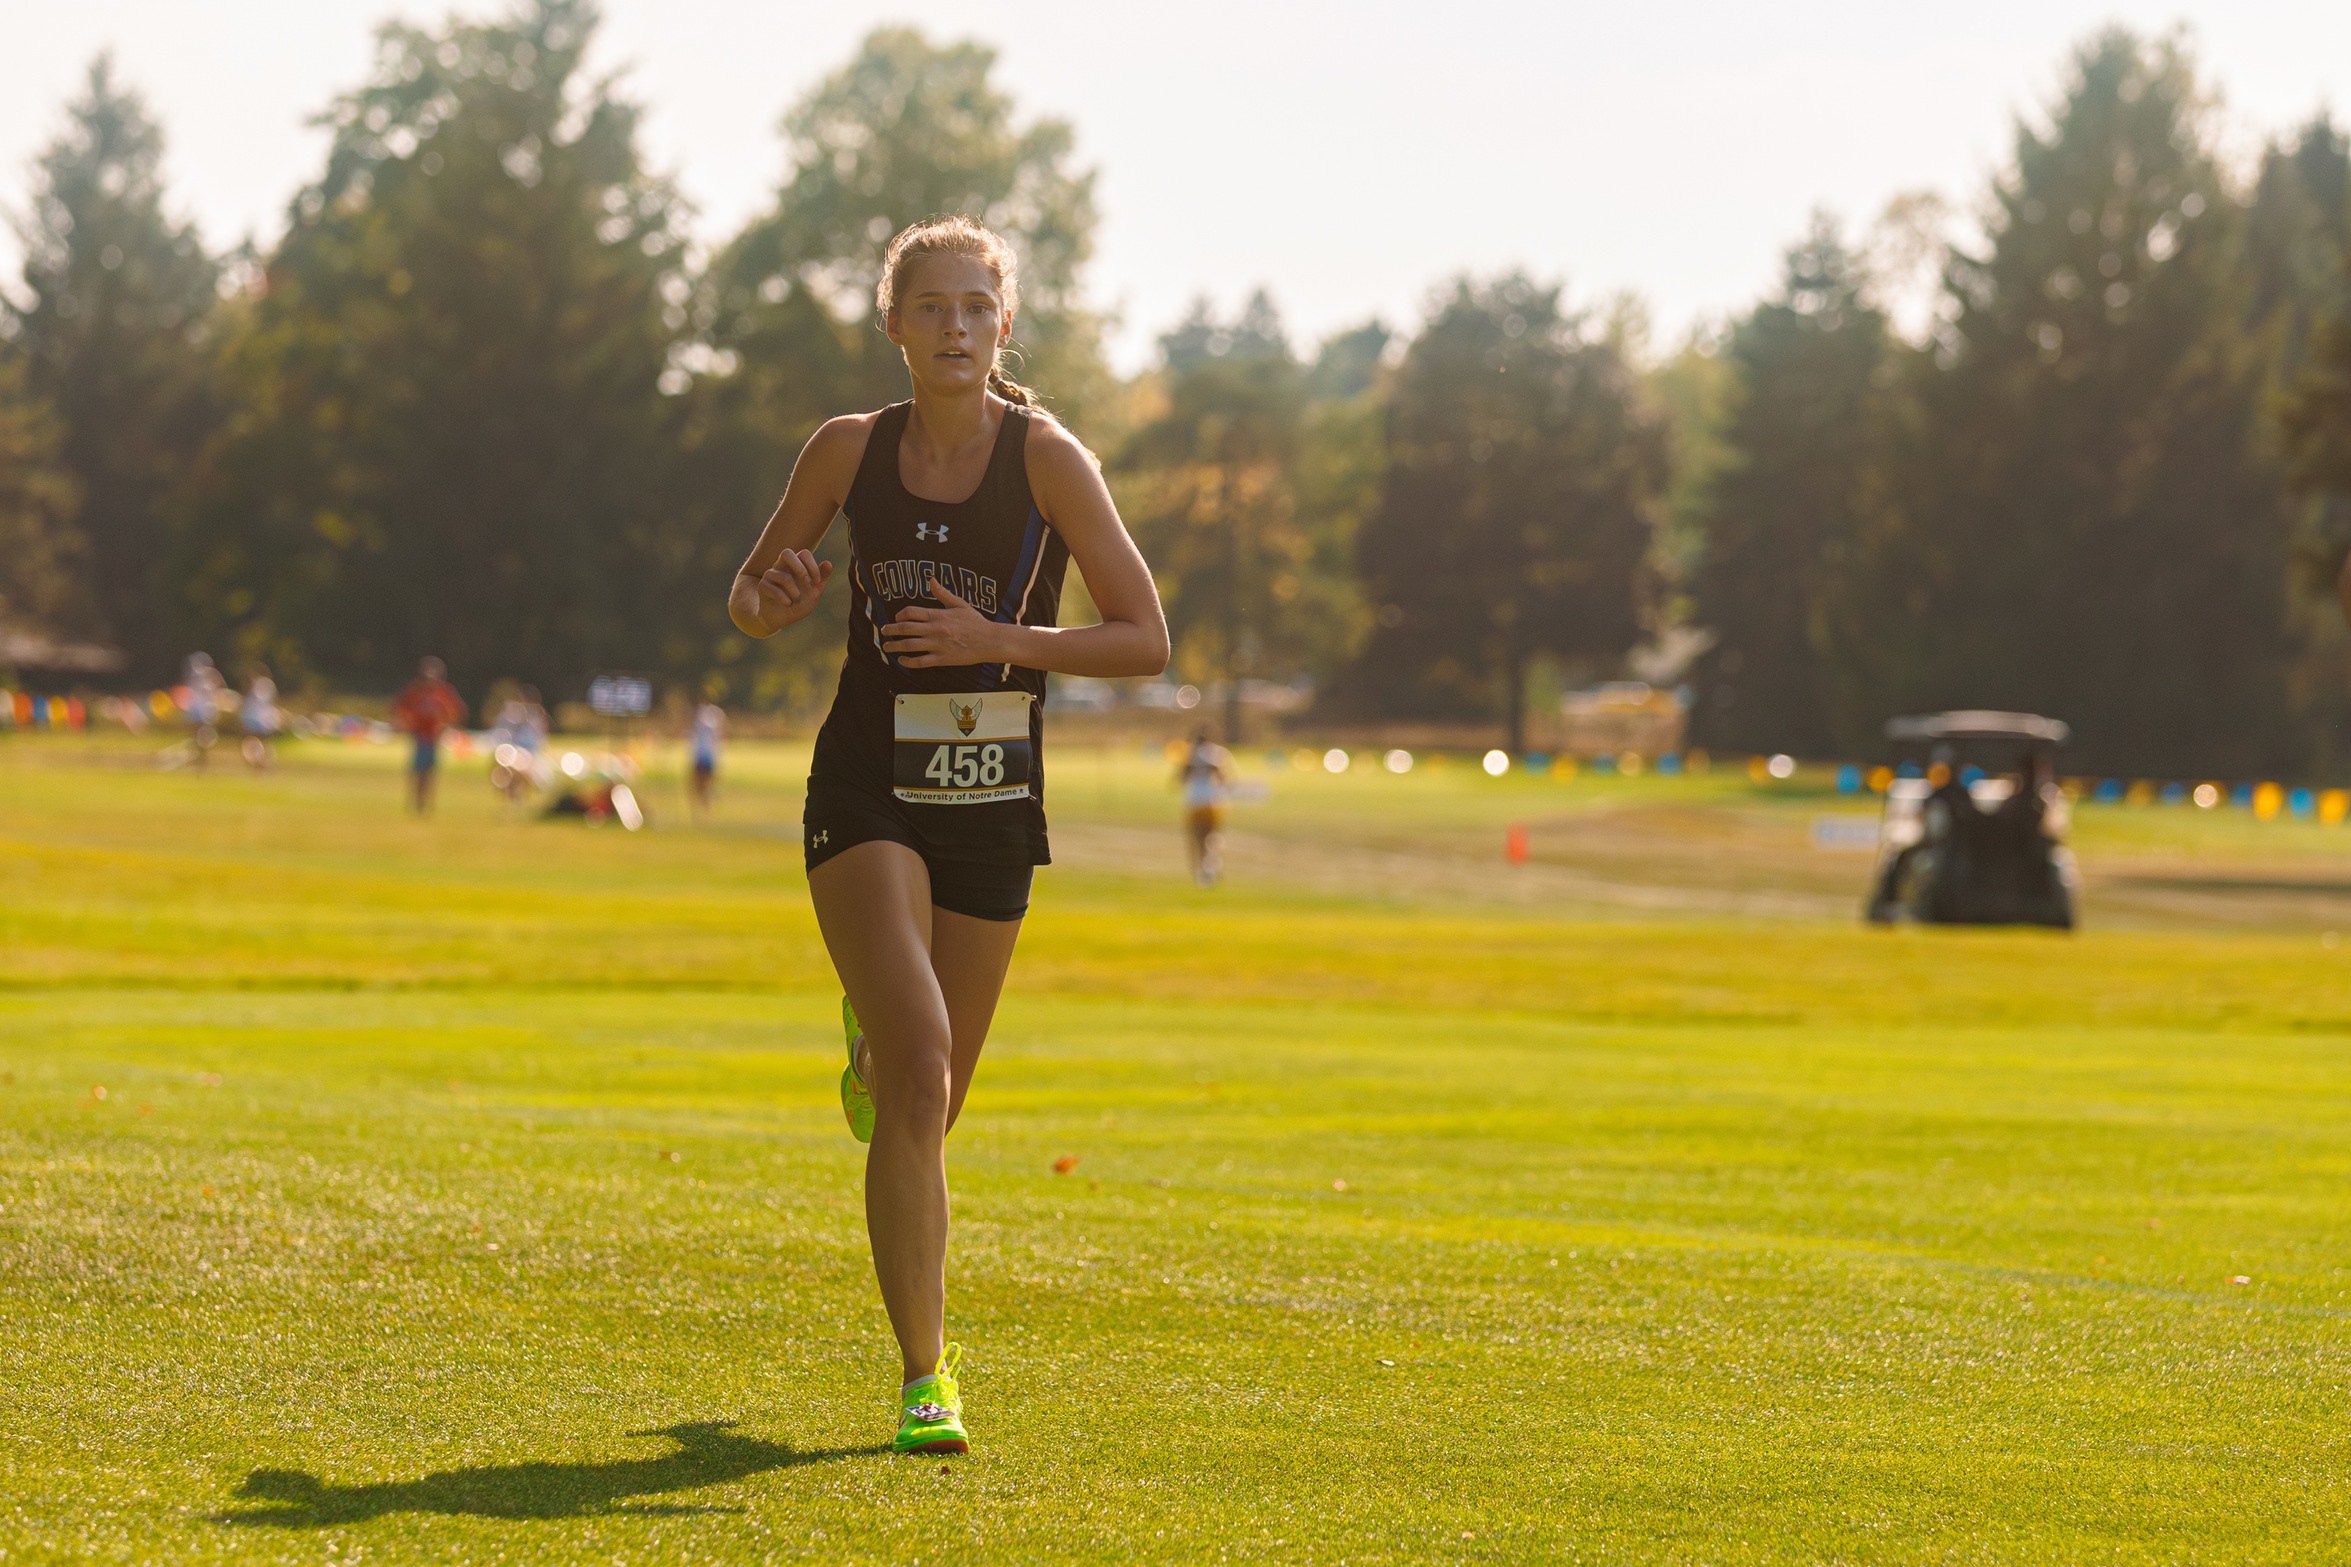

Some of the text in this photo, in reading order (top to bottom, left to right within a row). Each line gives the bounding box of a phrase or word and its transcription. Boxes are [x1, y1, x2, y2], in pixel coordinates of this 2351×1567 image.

[872, 559, 997, 614] COUGARS
[925, 743, 1005, 787] 458
[906, 789, 1017, 801] University of Notre Dame
